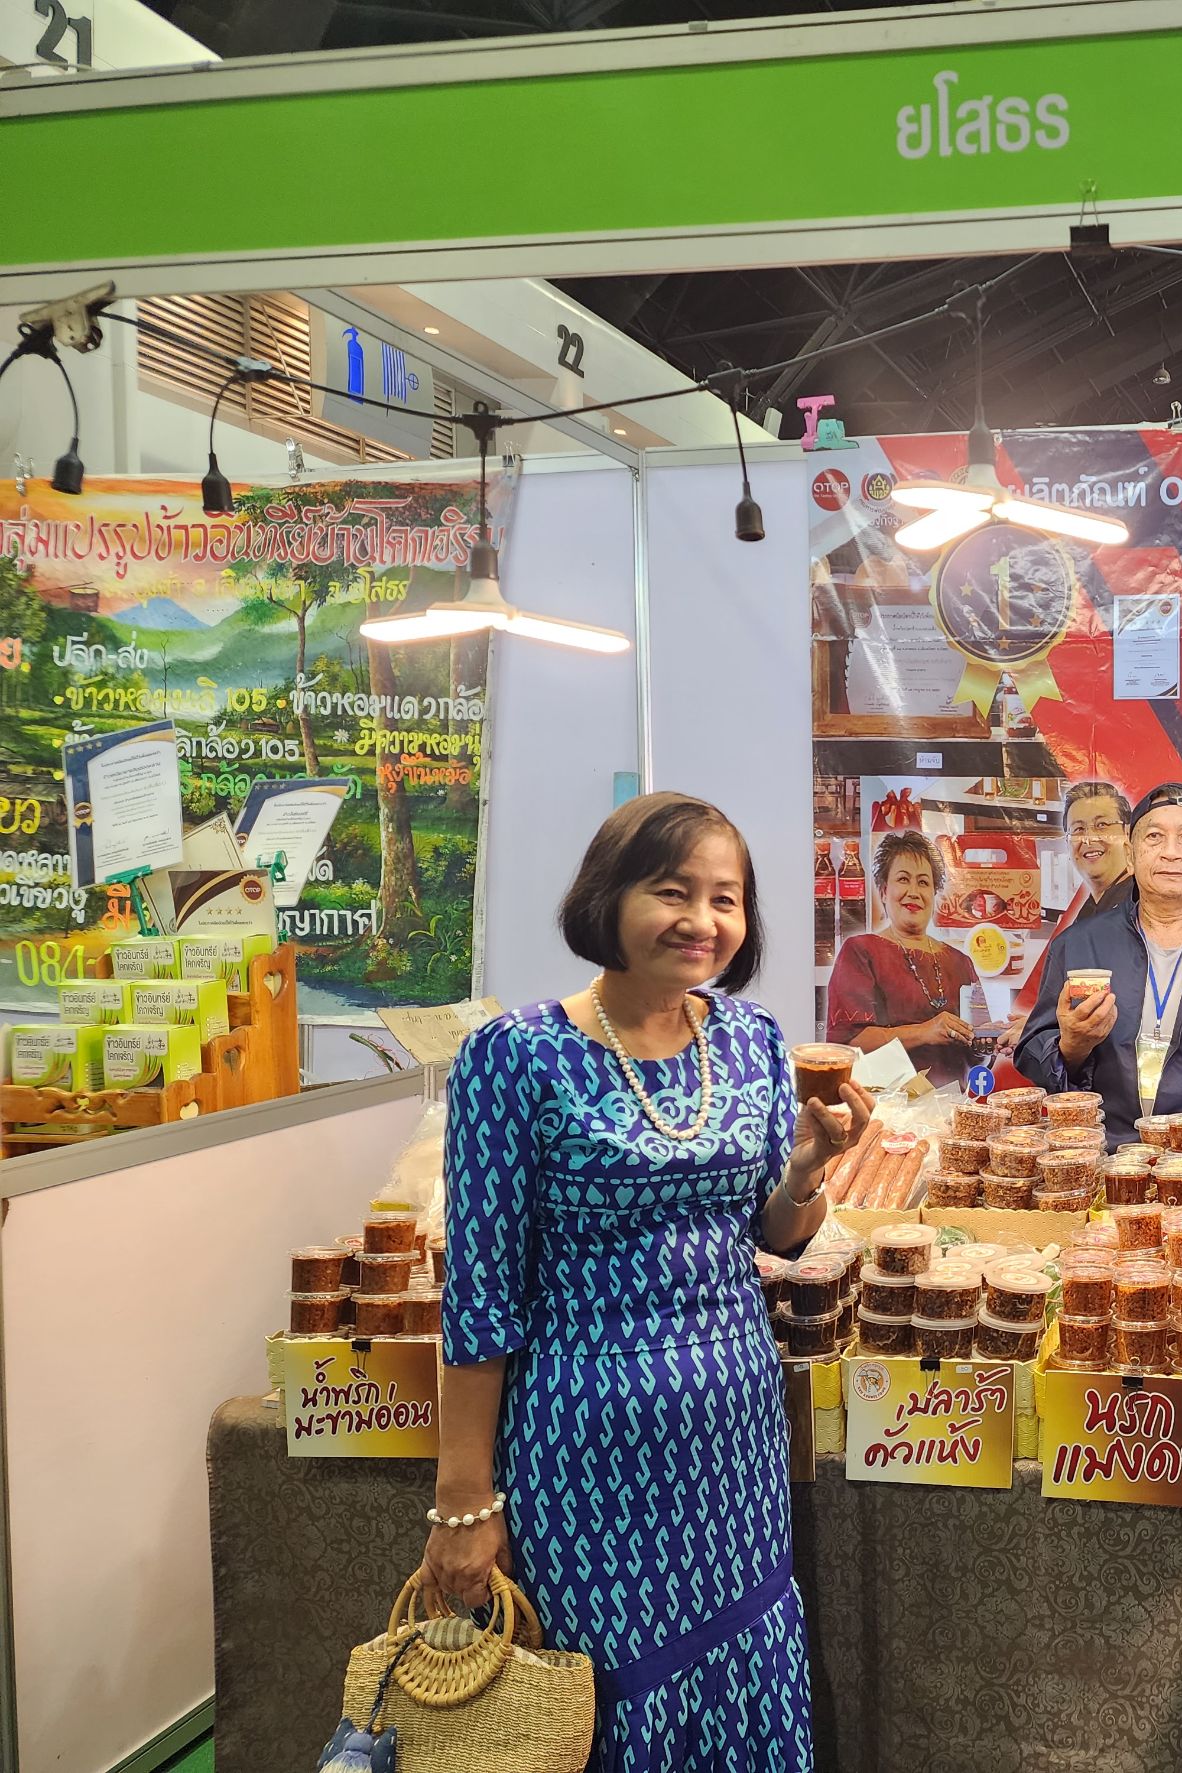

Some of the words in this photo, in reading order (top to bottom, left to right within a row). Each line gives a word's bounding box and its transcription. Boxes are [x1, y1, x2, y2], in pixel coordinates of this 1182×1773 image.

[34, 0, 92, 72] 21
[896, 69, 1070, 160] ยโสธร
[557, 323, 585, 378] 22
[813, 481, 849, 493] OTOP
[226, 686, 267, 713] 105
[260, 739, 300, 760] 105
[301, 1357, 380, 1409] น้ำพริก
[907, 1367, 1011, 1417] ปลาร้า
[294, 1381, 432, 1440] มะขามอ่อน
[863, 1404, 982, 1468] คั่วแห้ง
[1084, 1388, 1175, 1440] นรก
